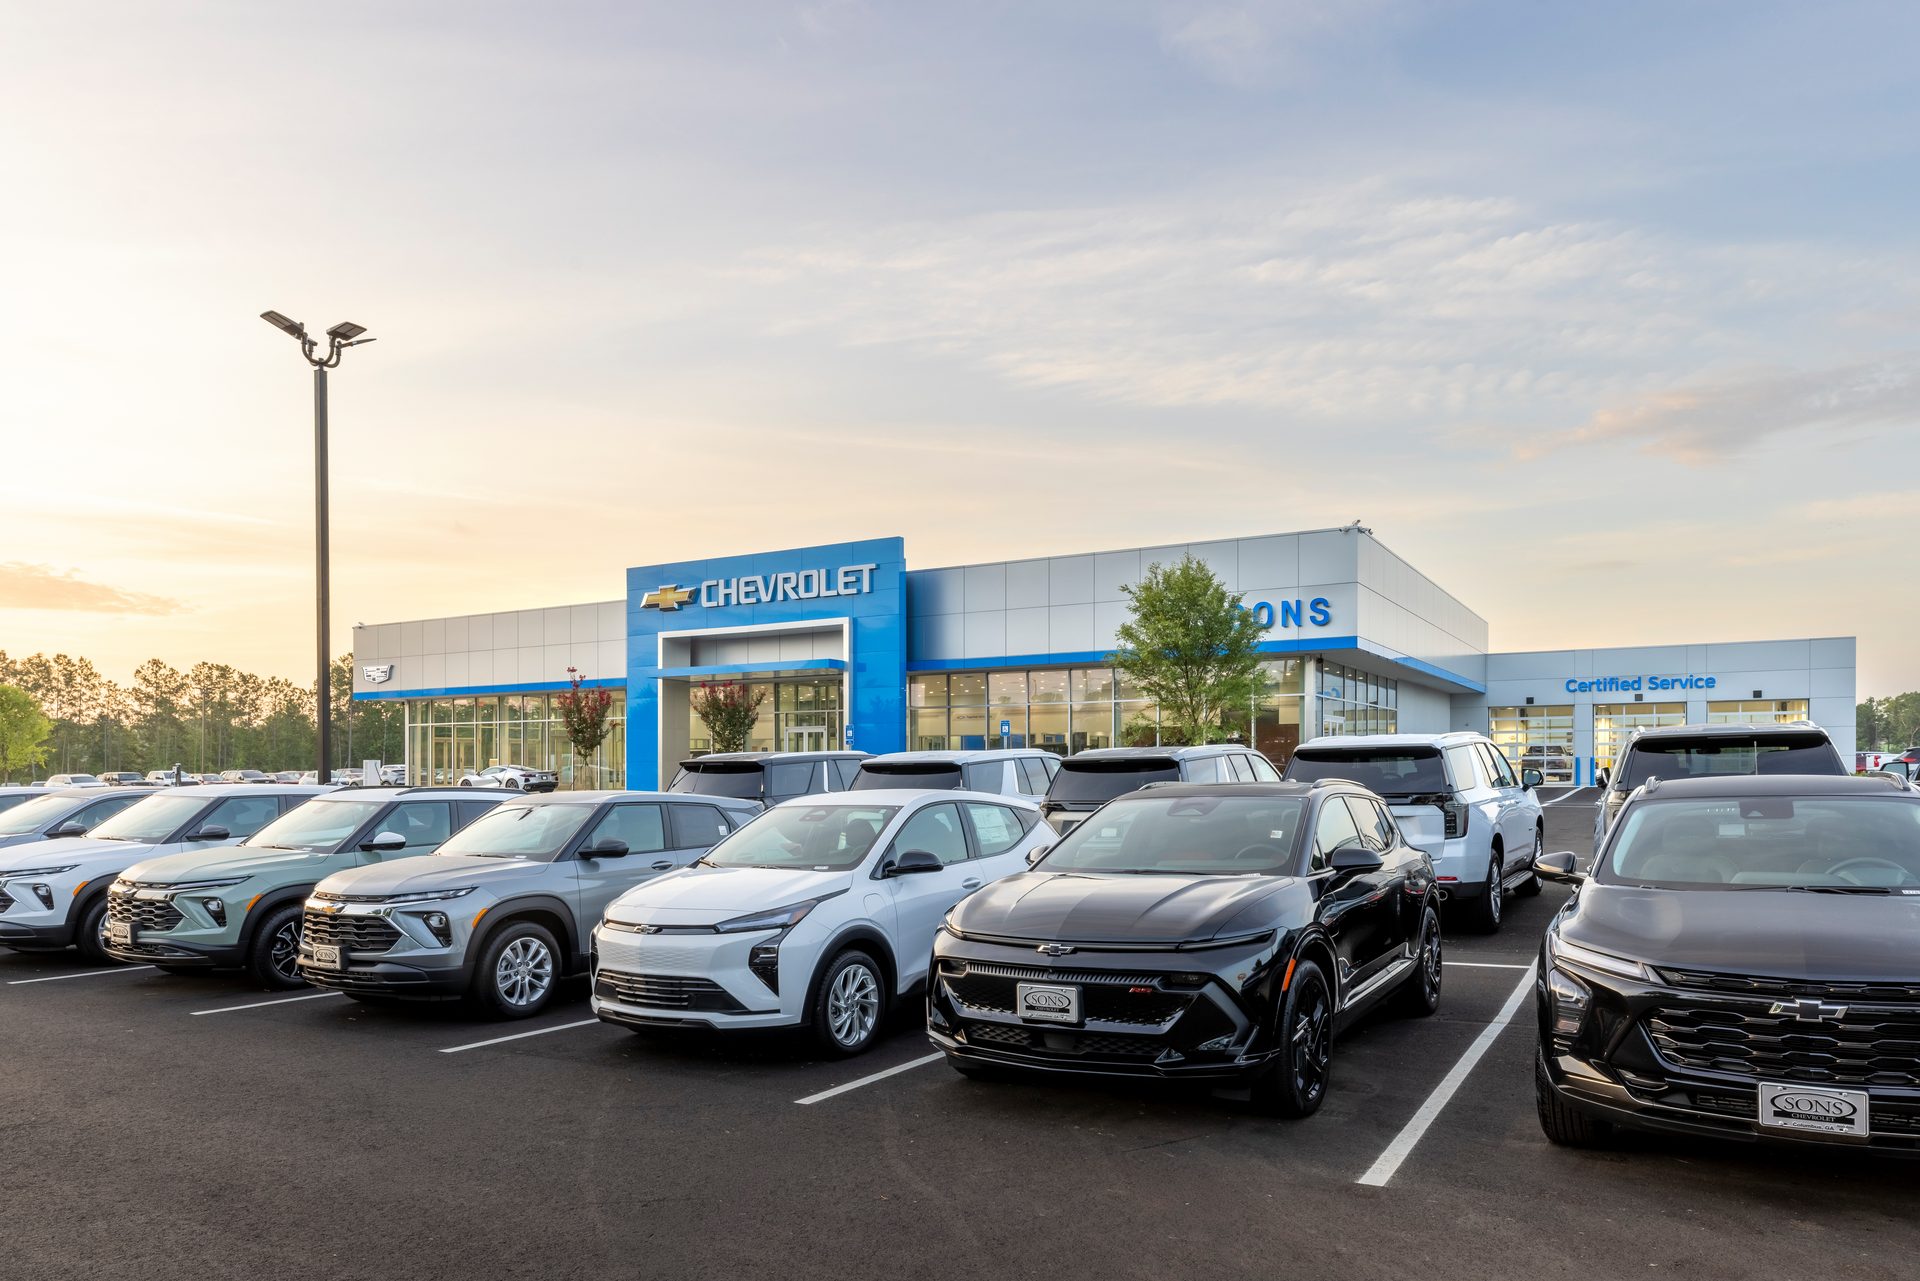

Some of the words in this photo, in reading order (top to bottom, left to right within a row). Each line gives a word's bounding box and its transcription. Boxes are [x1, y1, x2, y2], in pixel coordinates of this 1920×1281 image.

[701, 563, 877, 608] CHEVROLET
[1565, 676, 1642, 693] Certified
[1648, 674, 1717, 691] Service
[1031, 994, 1064, 1007] SONS
[1784, 1097, 1843, 1115] SONS
[1791, 1112, 1836, 1122] CHEVROLET
